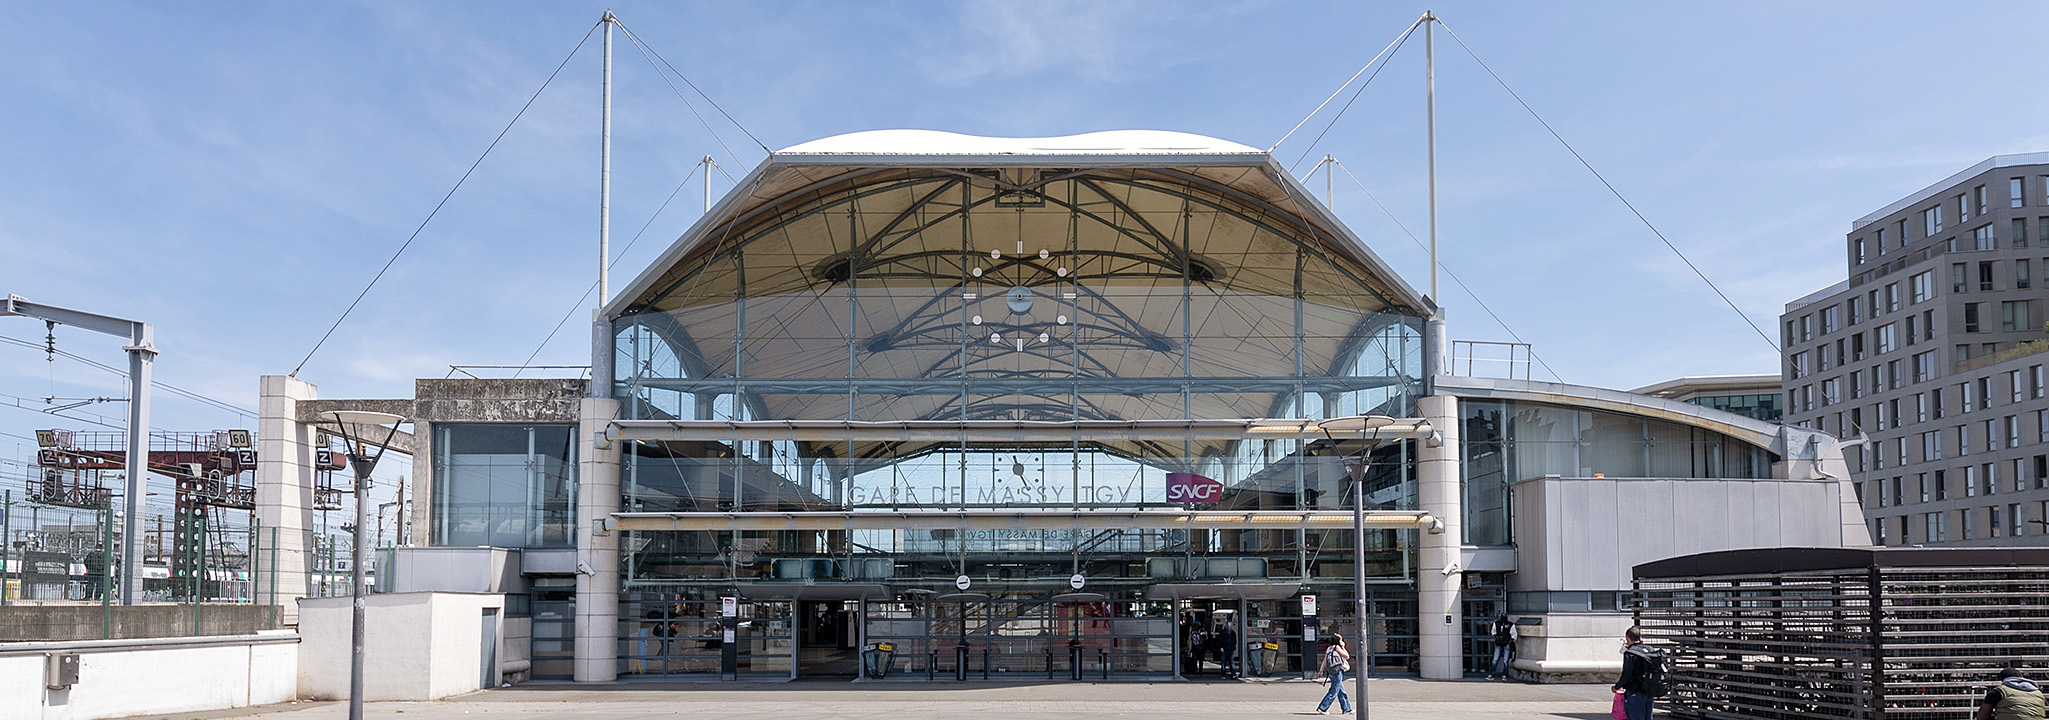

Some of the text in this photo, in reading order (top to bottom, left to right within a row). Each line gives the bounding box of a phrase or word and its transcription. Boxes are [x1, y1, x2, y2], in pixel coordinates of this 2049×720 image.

[39, 433, 52, 444] 70
[233, 433, 246, 444] 60
[240, 451, 252, 462] Z
[318, 452, 329, 462] Z
[848, 486, 1132, 504] GARE DE MASSY TGV
[1168, 484, 1220, 499] SNCF
